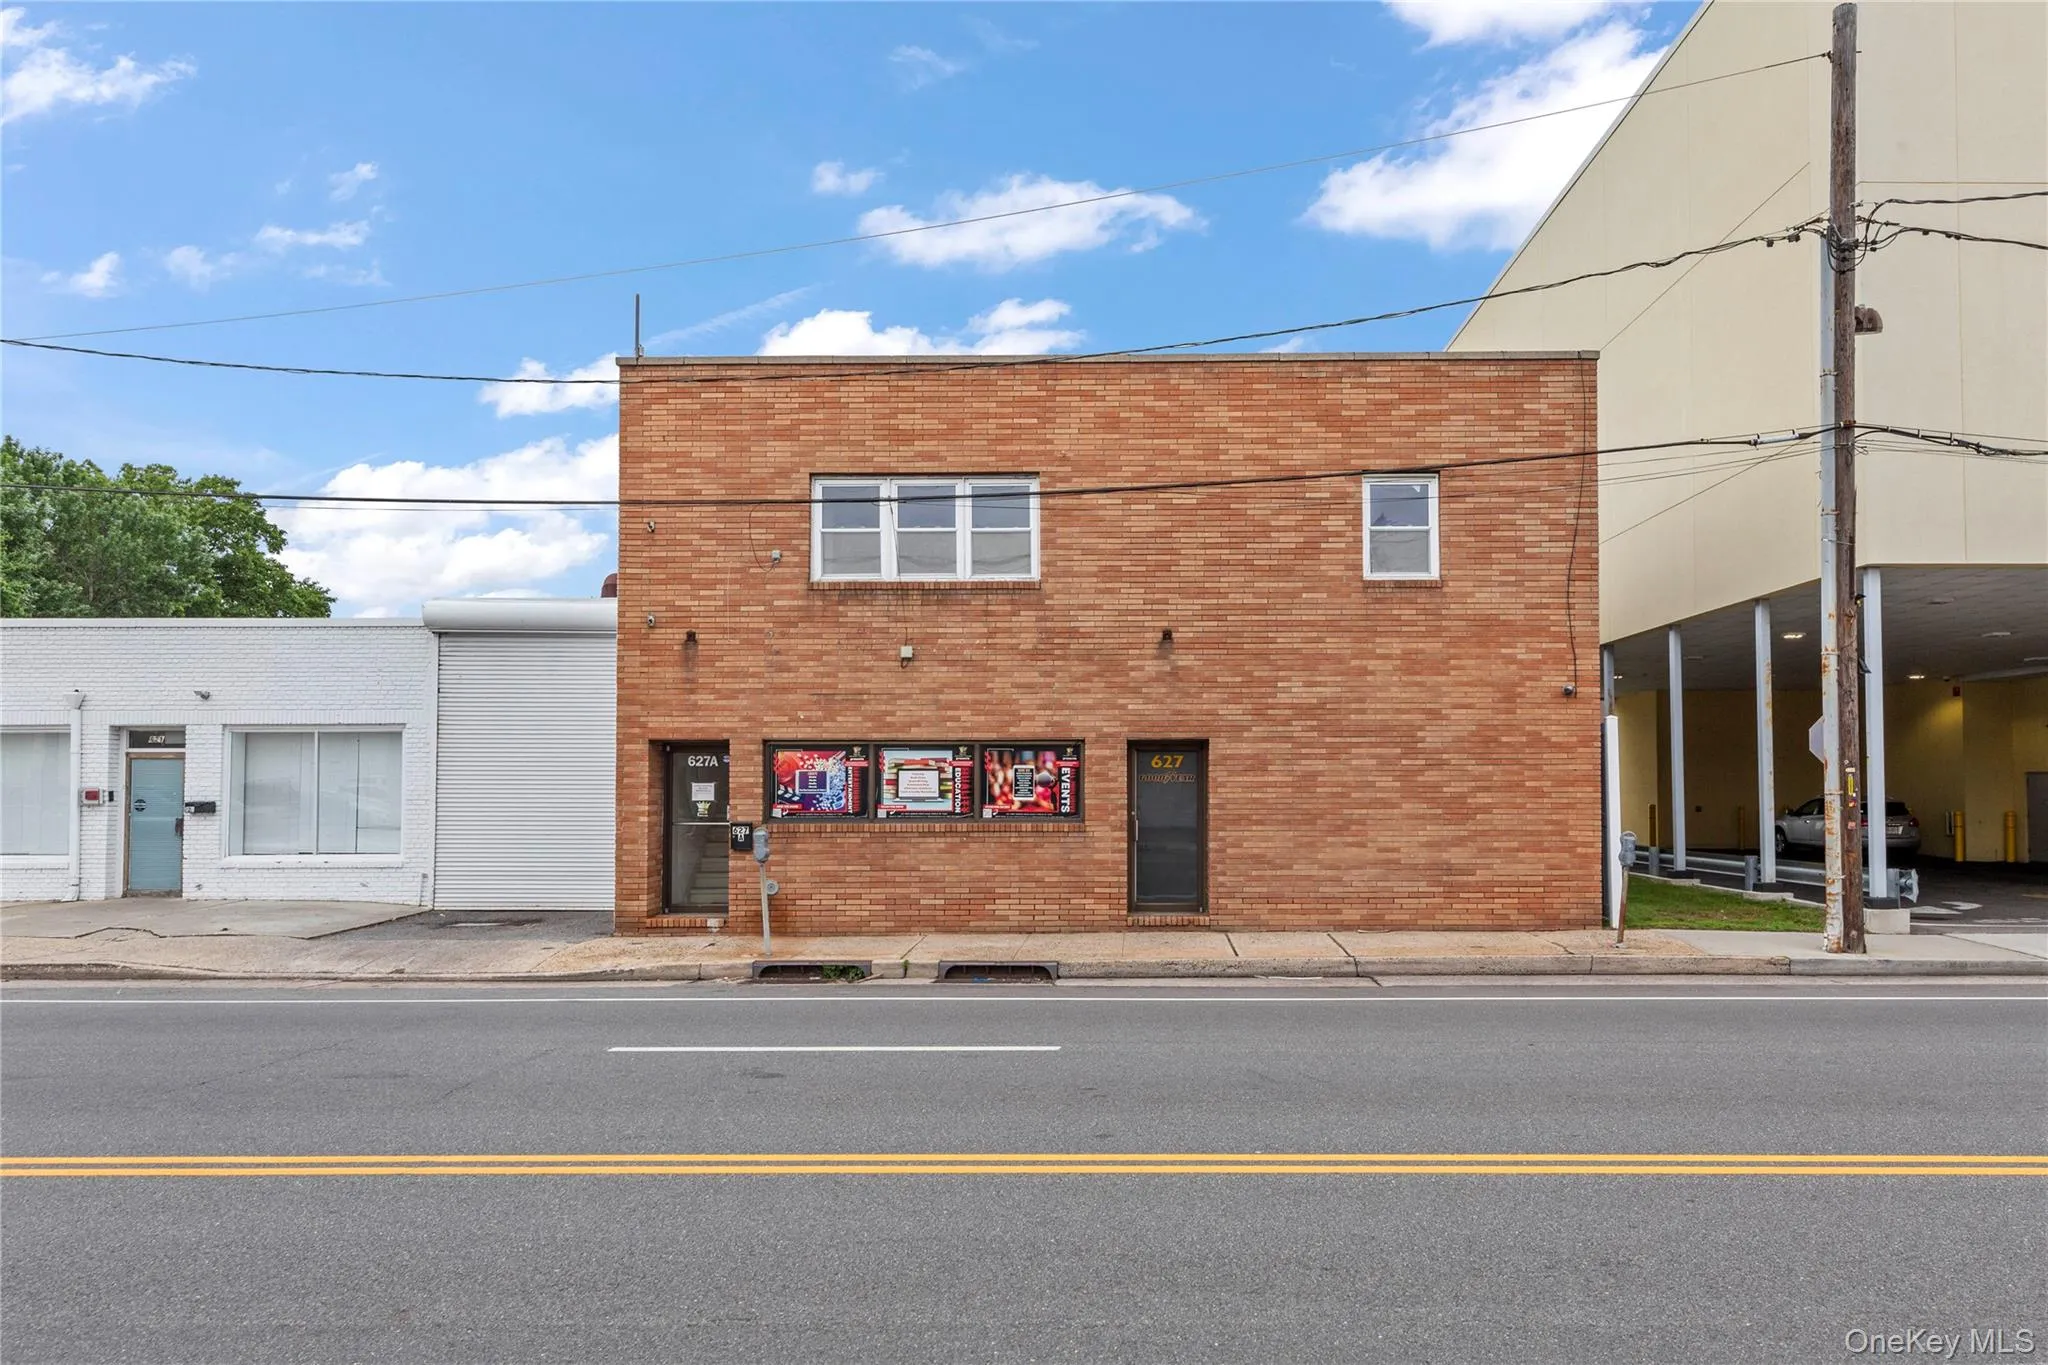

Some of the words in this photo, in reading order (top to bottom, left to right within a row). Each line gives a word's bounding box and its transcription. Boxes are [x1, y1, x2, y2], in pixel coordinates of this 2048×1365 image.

[687, 755, 719, 768] 627A
[1151, 754, 1185, 768] 627
[1060, 767, 1071, 813] EVENTS
[733, 826, 748, 834] 627
